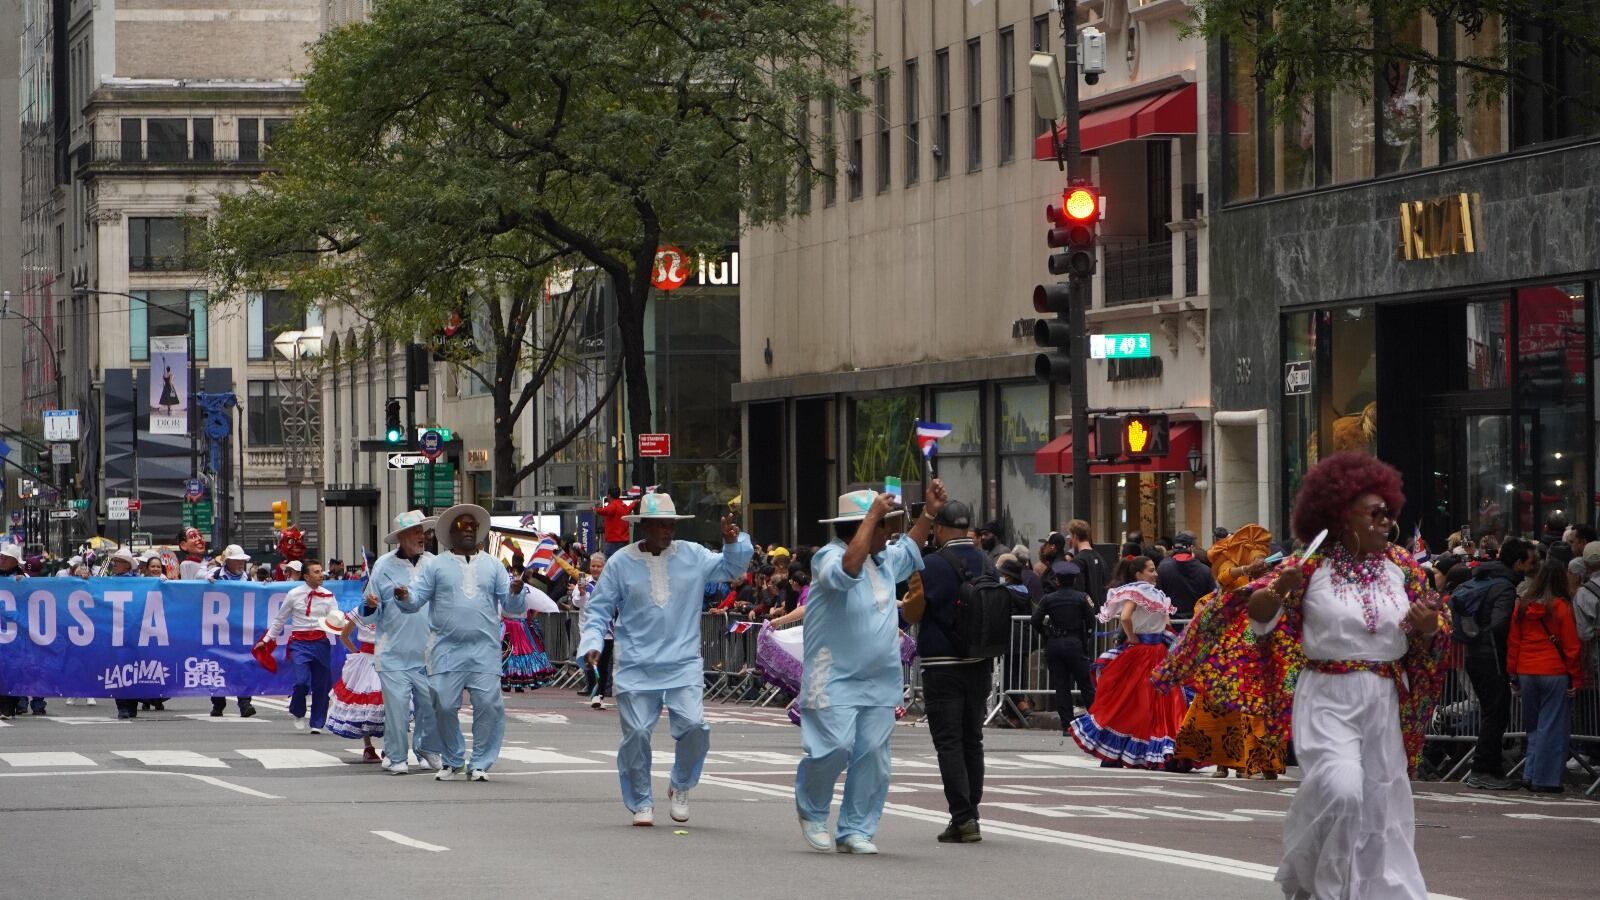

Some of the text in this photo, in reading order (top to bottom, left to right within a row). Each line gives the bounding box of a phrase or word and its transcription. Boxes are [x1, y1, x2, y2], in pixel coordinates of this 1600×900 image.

[1105, 338, 1116, 356] W
[1120, 337, 1136, 355] 49
[1289, 372, 1299, 385] ONE
[156, 419, 181, 427] DIOR
[394, 456, 429, 464] ONE WA
[0, 590, 169, 647] COSTA
[185, 657, 220, 675] Caña
[184, 672, 226, 688] Brava
